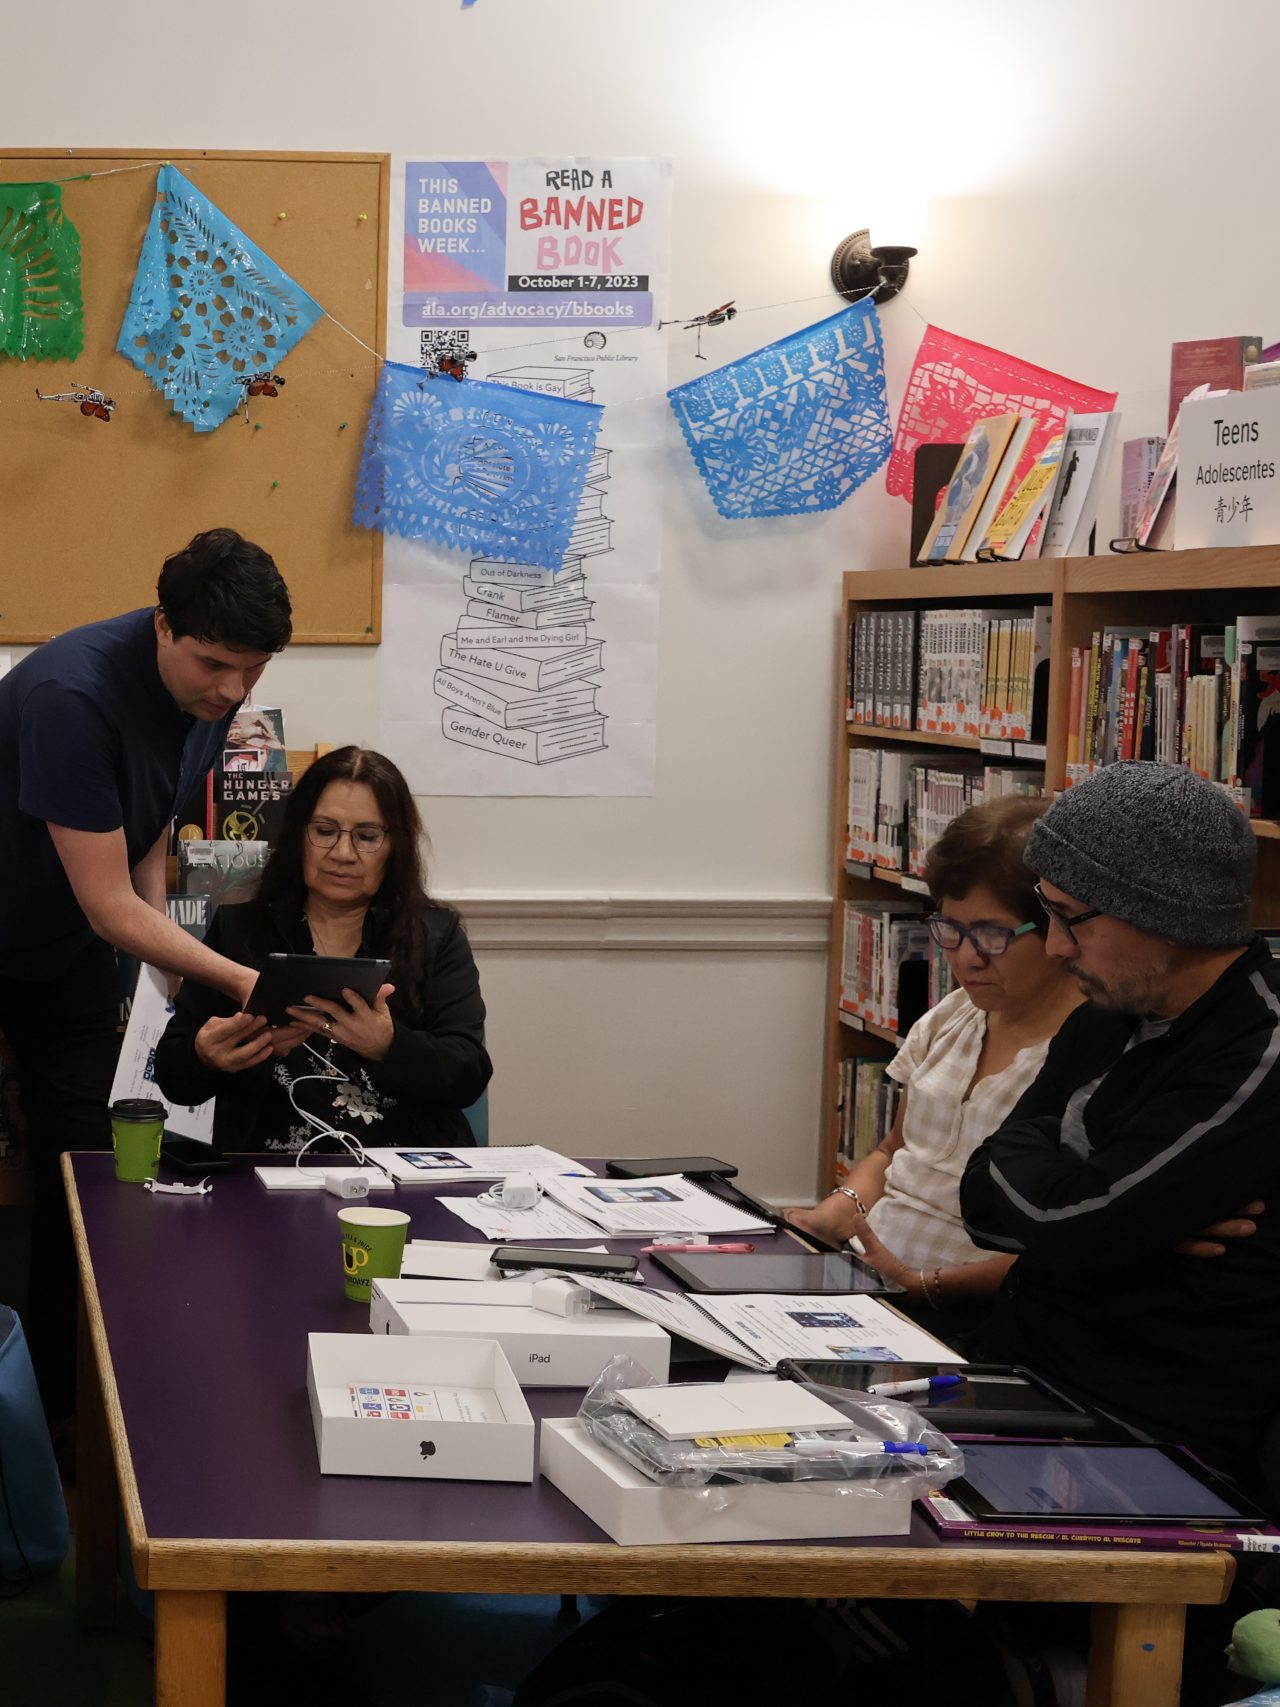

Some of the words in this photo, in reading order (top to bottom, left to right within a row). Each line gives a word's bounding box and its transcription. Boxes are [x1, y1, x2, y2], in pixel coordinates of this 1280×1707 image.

[419, 178, 458, 194] THIS
[545, 168, 594, 191] READ
[601, 169, 613, 189] A
[419, 198, 492, 214] BANNED
[519, 195, 644, 232] BANNED
[419, 218, 477, 234] BOOKS
[417, 238, 485, 253] WEEK...
[536, 235, 624, 273] BOOK
[518, 276, 575, 289] October
[578, 276, 601, 290] 1-7,
[605, 276, 639, 289] 2023
[422, 301, 634, 321] ala.org/advocacy/bbooks
[536, 382, 544, 392] is
[545, 383, 562, 395] Gay
[1213, 419, 1259, 446] Teens
[1196, 459, 1275, 485] Adolescentes
[1214, 495, 1254, 524] 青少年
[481, 568, 495, 577] Out
[497, 568, 505, 577] of
[507, 570, 542, 579] Darkness
[476, 585, 505, 601] Crank
[486, 608, 520, 623] Flamer
[461, 636, 473, 645] Me
[475, 636, 490, 644] and
[492, 636, 507, 644] Earl
[508, 635, 523, 644] and
[525, 635, 539, 643] the
[540, 634, 564, 644] Dying
[565, 633, 579, 642] Girl
[449, 648, 467, 662] The
[469, 654, 492, 669] Hate
[495, 662, 503, 672] U
[505, 665, 527, 679] Give
[450, 720, 490, 740] Gender
[492, 732, 527, 750] Queer
[223, 780, 289, 790] HUNGER
[223, 791, 281, 801] GAMES
[528, 1353, 551, 1364] iPad
[1030, 1532, 1055, 1540] RESCUE
